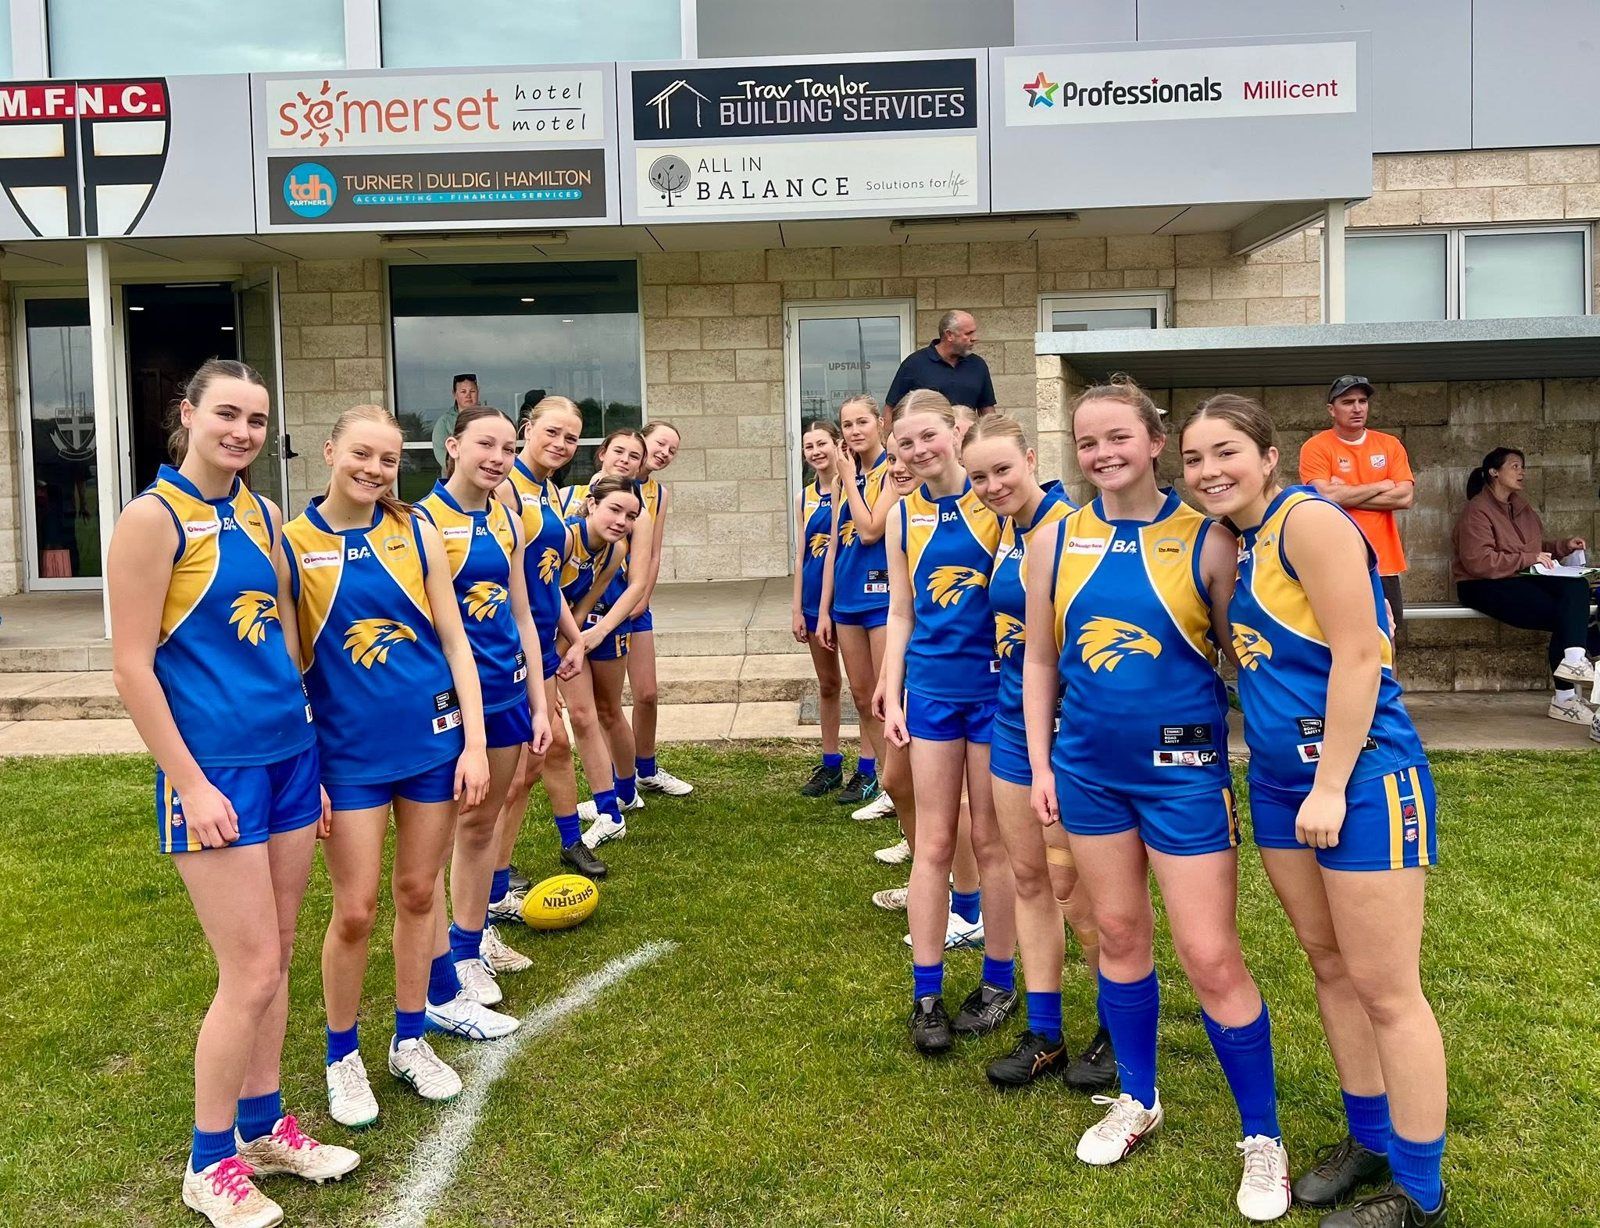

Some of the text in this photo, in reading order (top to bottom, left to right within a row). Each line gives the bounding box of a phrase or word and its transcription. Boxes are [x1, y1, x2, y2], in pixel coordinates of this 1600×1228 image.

[0, 86, 161, 117] M.F.N.C.
[515, 82, 582, 101] hotel
[738, 74, 869, 108] Trav Taylor
[1063, 77, 1338, 107] Professionals Millicent
[720, 94, 965, 126] BUILDING SERVICES
[512, 113, 586, 132] motel
[697, 156, 762, 173] ALL IN
[342, 170, 591, 190] TURNER DULDIG HAMILTON
[697, 177, 850, 200] BALANCE
[866, 170, 969, 197] Solutions for life
[356, 194, 432, 202] ACCOUNTING
[521, 191, 579, 199] SERVICES
[542, 885, 594, 908] SHERRIN
